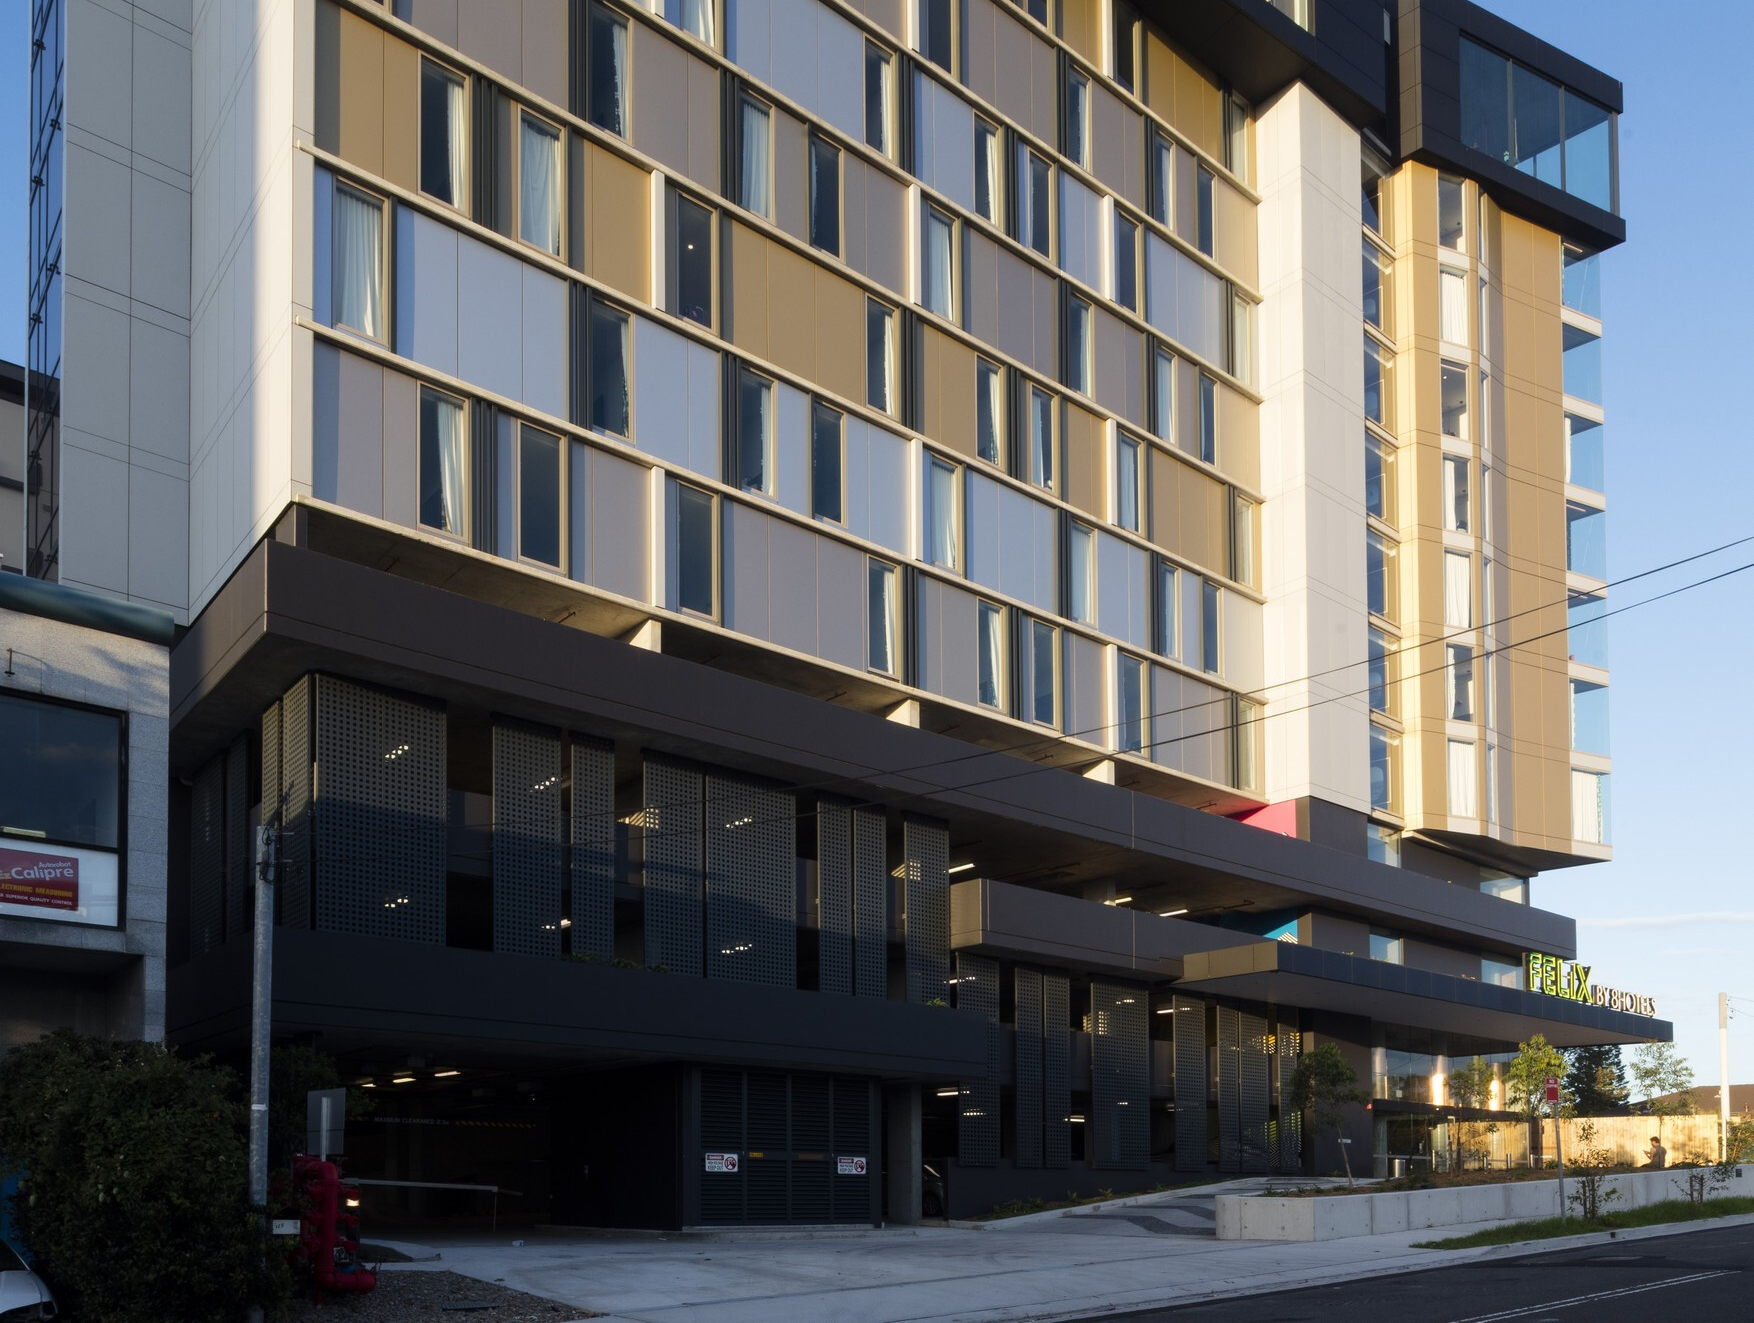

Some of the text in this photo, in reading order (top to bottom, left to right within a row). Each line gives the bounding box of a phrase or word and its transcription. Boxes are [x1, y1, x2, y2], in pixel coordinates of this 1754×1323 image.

[1529, 952, 1657, 1017] FELIX BY 8HOTELS
